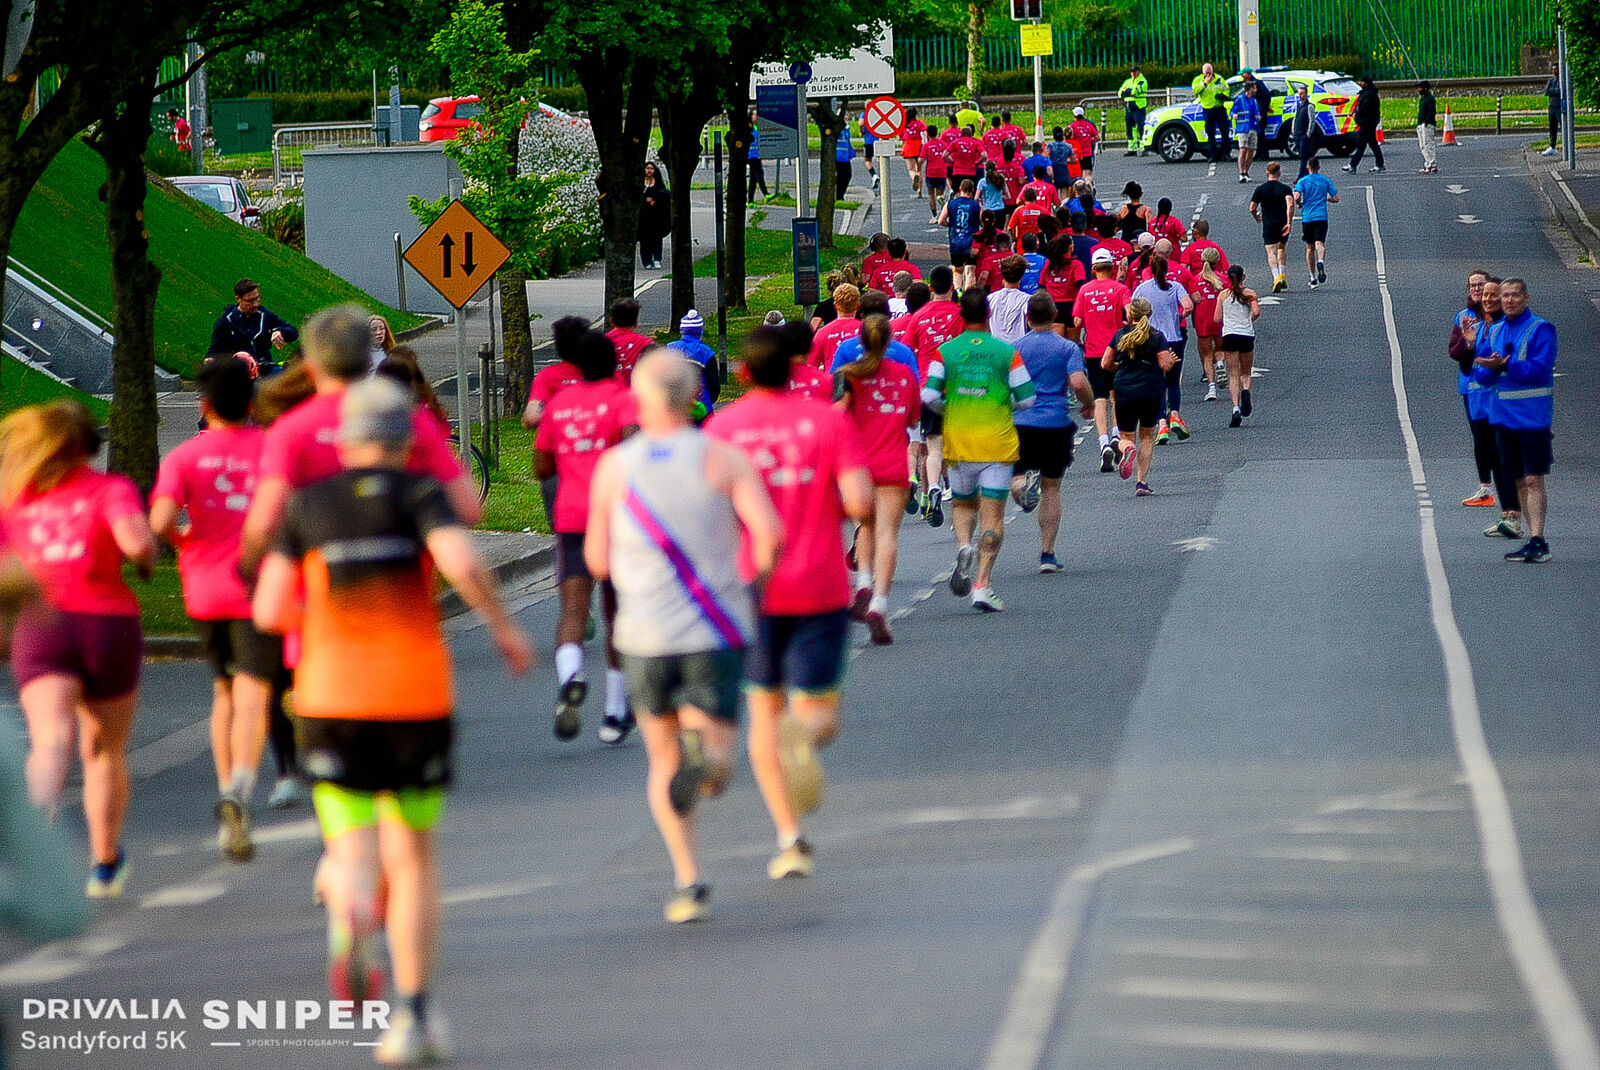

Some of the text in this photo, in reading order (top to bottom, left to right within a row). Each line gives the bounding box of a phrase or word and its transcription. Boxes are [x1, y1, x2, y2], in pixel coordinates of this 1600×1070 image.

[820, 75, 845, 83] Lorgan
[811, 83, 855, 93] BUSINESS
[857, 82, 879, 91] PARK
